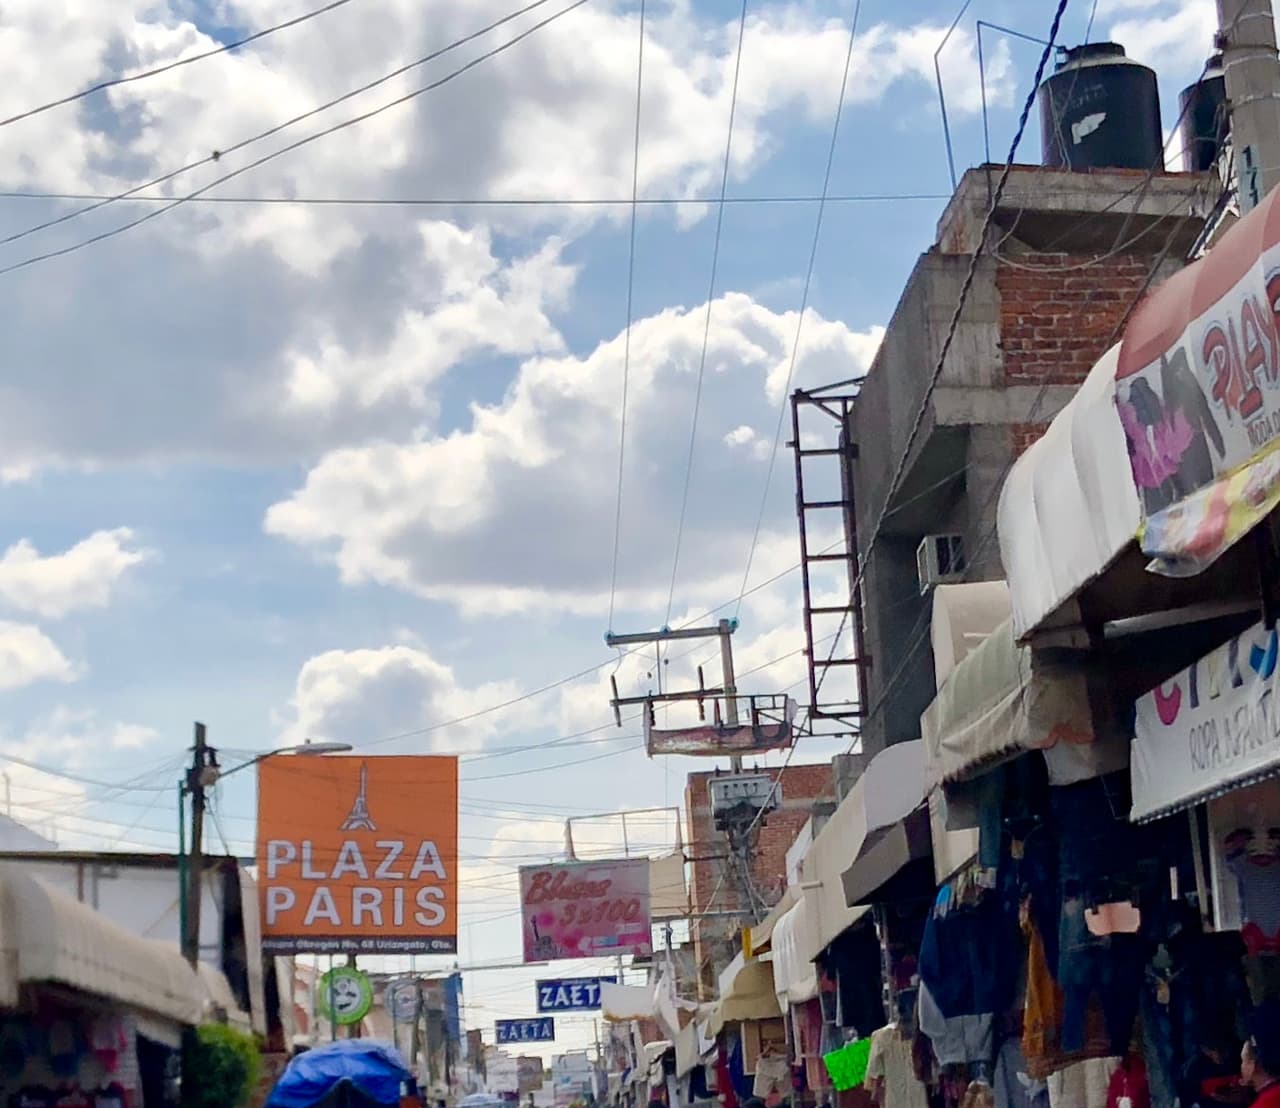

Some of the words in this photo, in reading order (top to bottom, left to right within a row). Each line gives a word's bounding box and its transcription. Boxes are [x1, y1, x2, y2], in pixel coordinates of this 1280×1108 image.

[267, 840, 447, 880] PLAZA
[266, 886, 446, 926] PARIS
[541, 983, 602, 1007] ZAET
[496, 1022, 551, 1040] ZAETA
